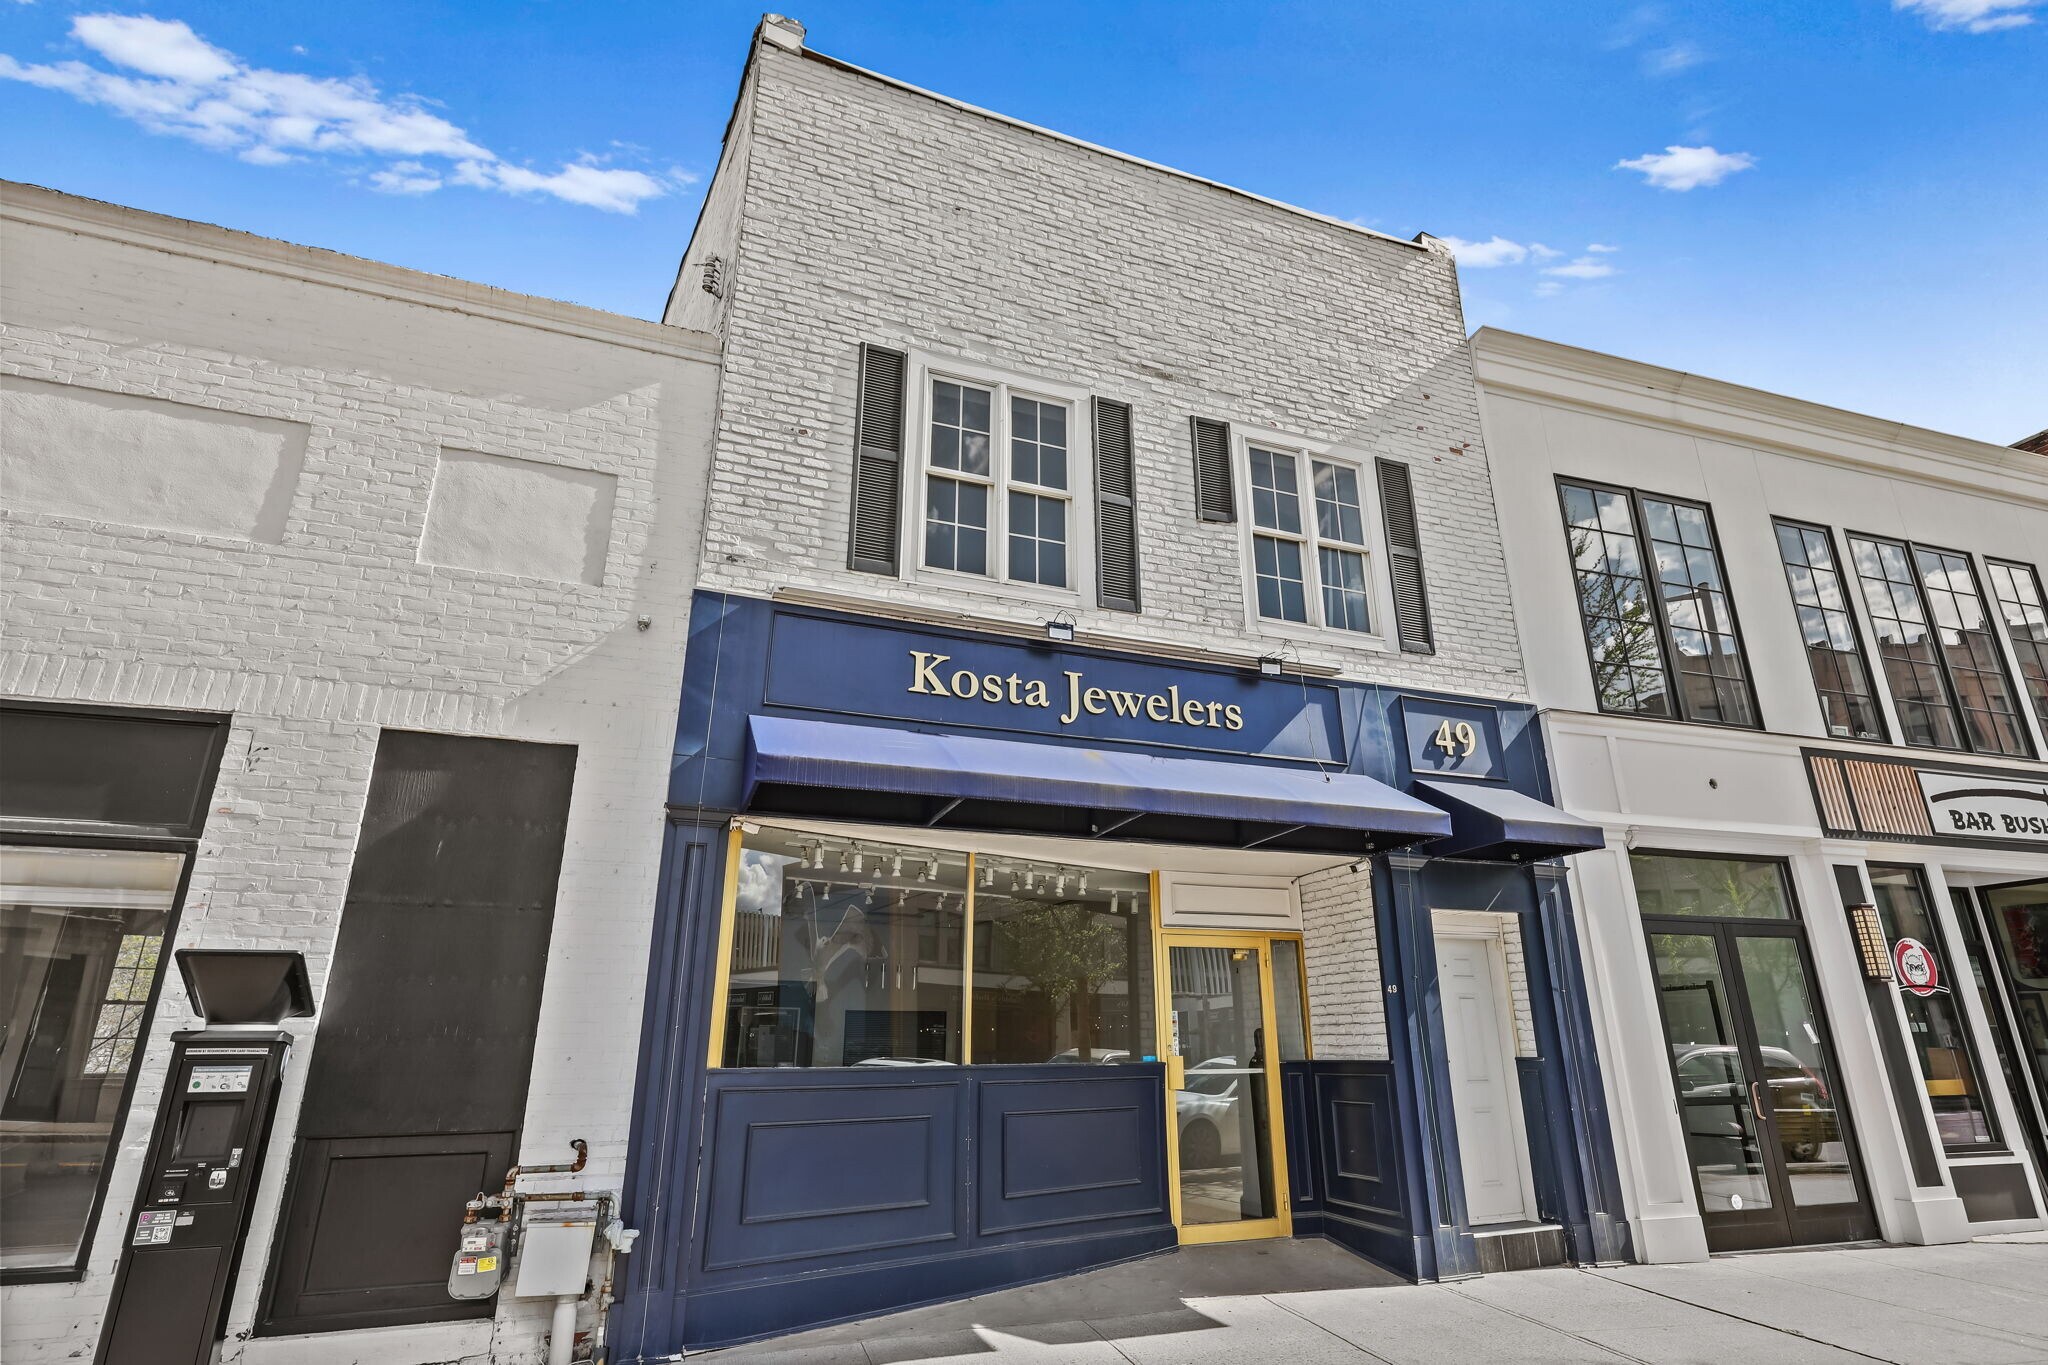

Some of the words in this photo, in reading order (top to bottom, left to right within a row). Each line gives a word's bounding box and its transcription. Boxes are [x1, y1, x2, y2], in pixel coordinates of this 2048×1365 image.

[908, 650, 1050, 708] Kosta
[1061, 670, 1244, 730] Jewelers
[1435, 719, 1476, 757] 49
[1948, 809, 1996, 831] BAR
